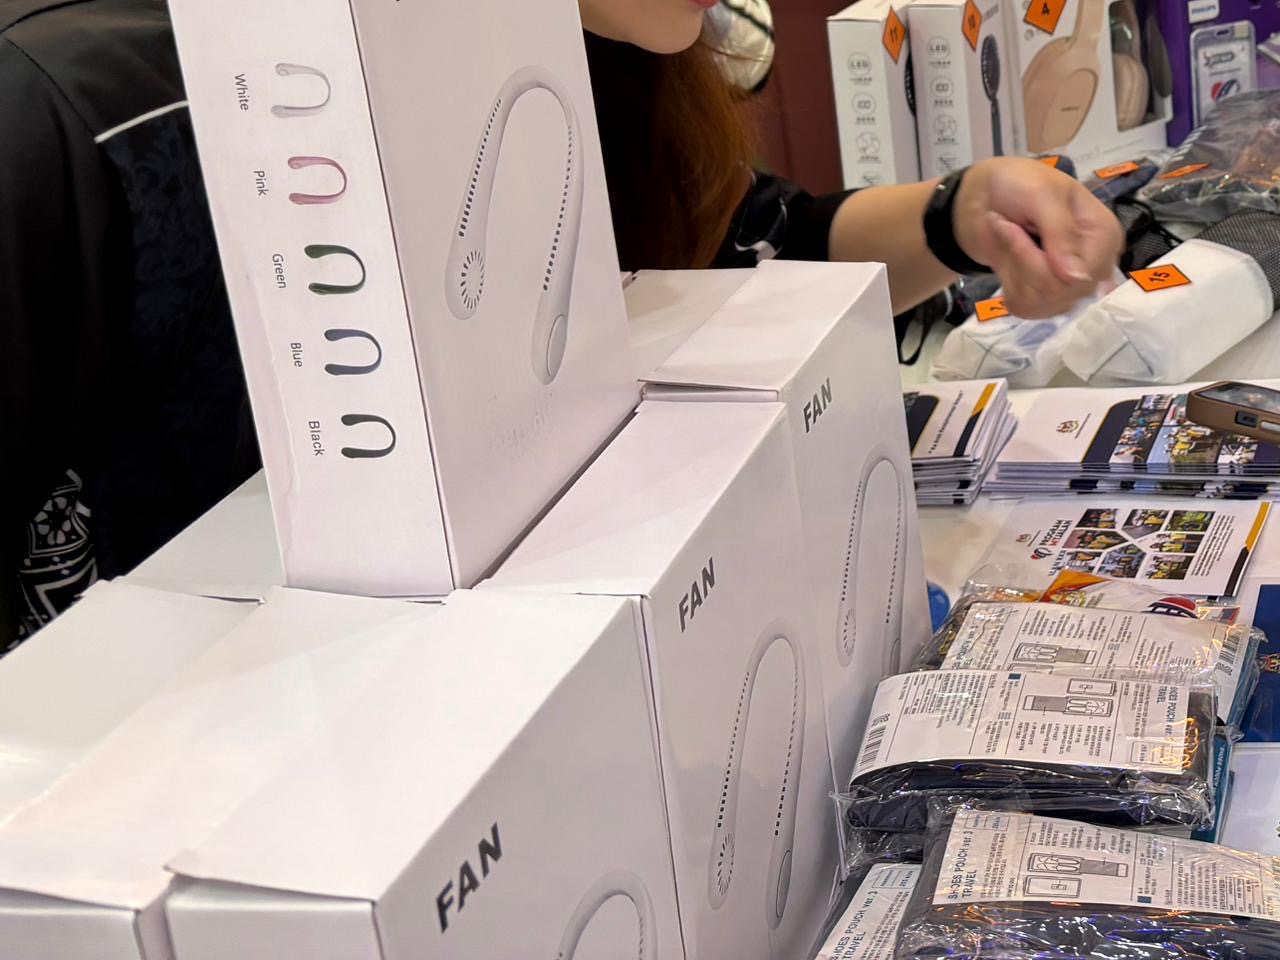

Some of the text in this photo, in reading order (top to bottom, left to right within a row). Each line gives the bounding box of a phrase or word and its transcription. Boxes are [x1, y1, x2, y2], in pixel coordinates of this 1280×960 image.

[1041, 1, 1051, 16] 4
[234, 72, 249, 111] White
[253, 169, 266, 197] Pink
[271, 252, 287, 290] Green
[1148, 270, 1171, 284] 15
[290, 341, 302, 369] Blue
[803, 377, 832, 433] FAN
[308, 420, 325, 457] Black
[679, 557, 717, 633] FAN
[1166, 702, 1177, 723] POUCH
[956, 848, 969, 873] POUCH
[436, 822, 503, 933] FAN
[962, 870, 977, 898] TRAVEL
[845, 910, 867, 934] POUCH
[842, 931, 866, 960] TRAVEL
